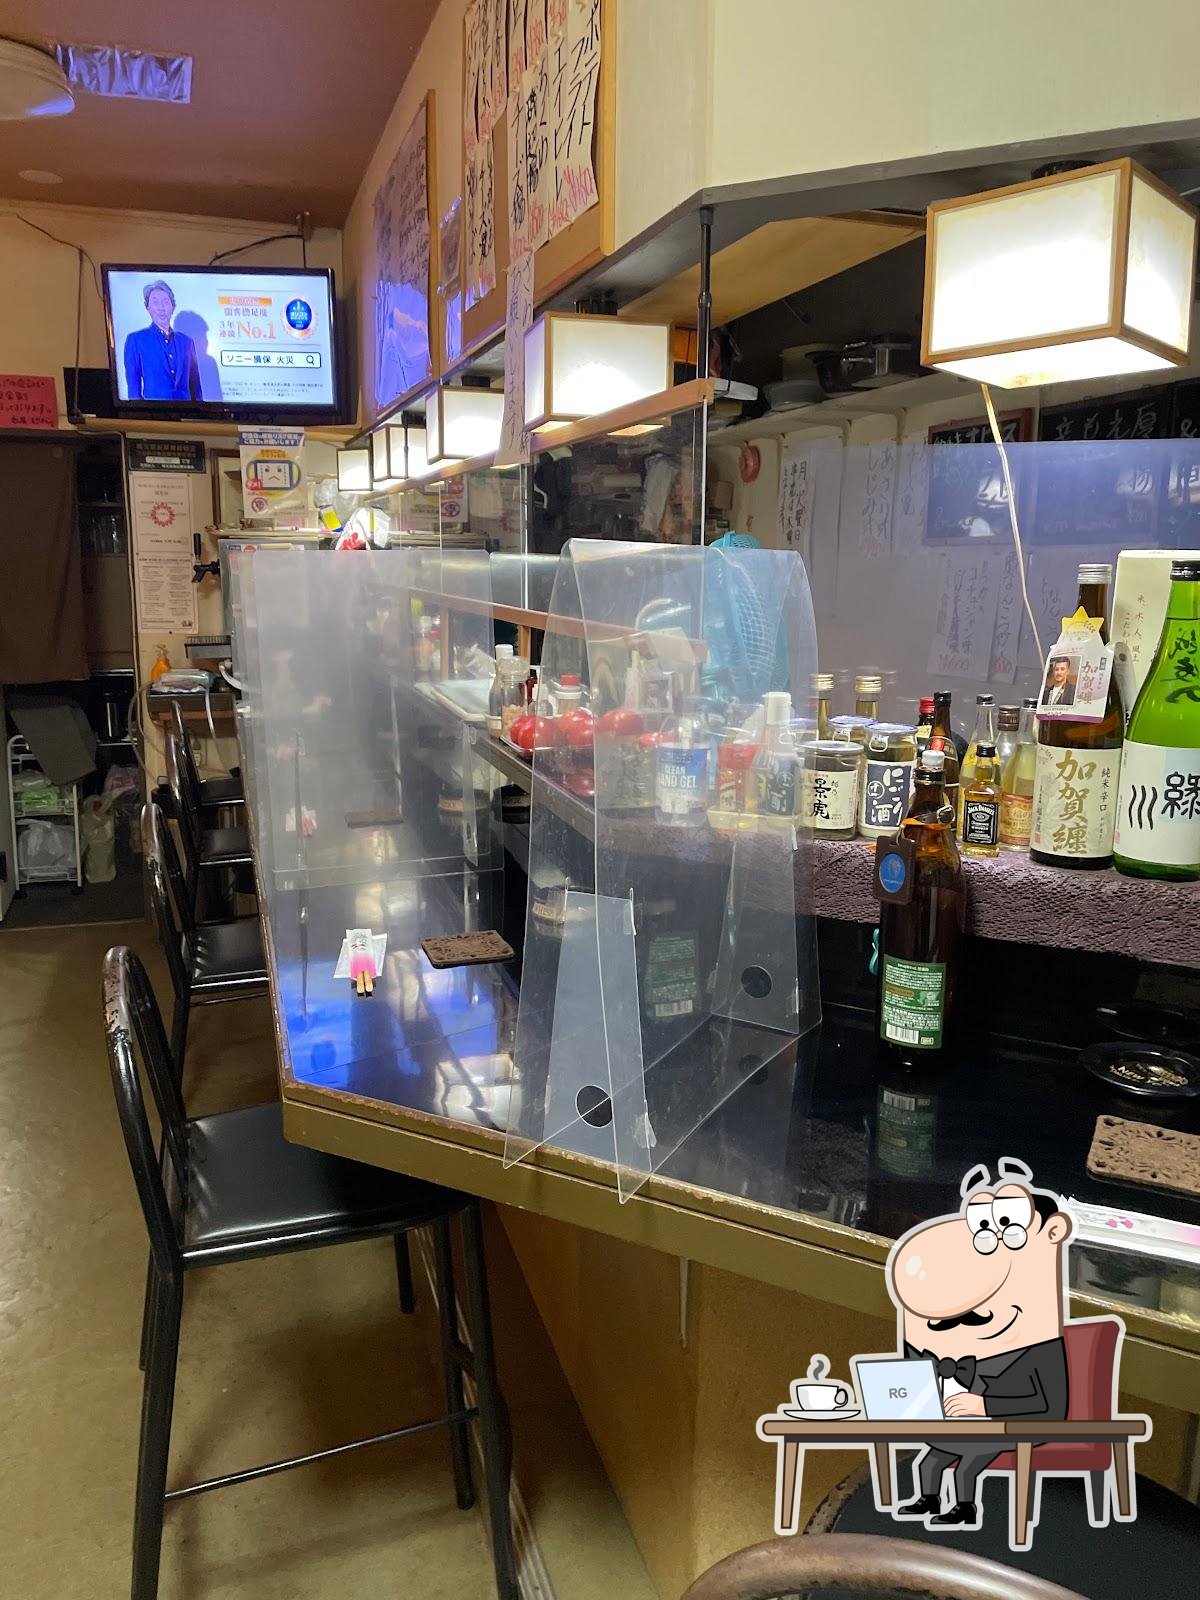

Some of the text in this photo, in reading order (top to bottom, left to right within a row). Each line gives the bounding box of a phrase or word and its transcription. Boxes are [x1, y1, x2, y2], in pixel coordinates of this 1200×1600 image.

[237, 320, 276, 339] No.1
[226, 354, 294, 364] ソニー損保 火災
[679, 775, 697, 788] GEL
[1099, 767, 1111, 812] 純米辛口
[812, 778, 832, 820] 景虎
[871, 799, 894, 823] 酒
[1052, 749, 1097, 854] 加賀纏
